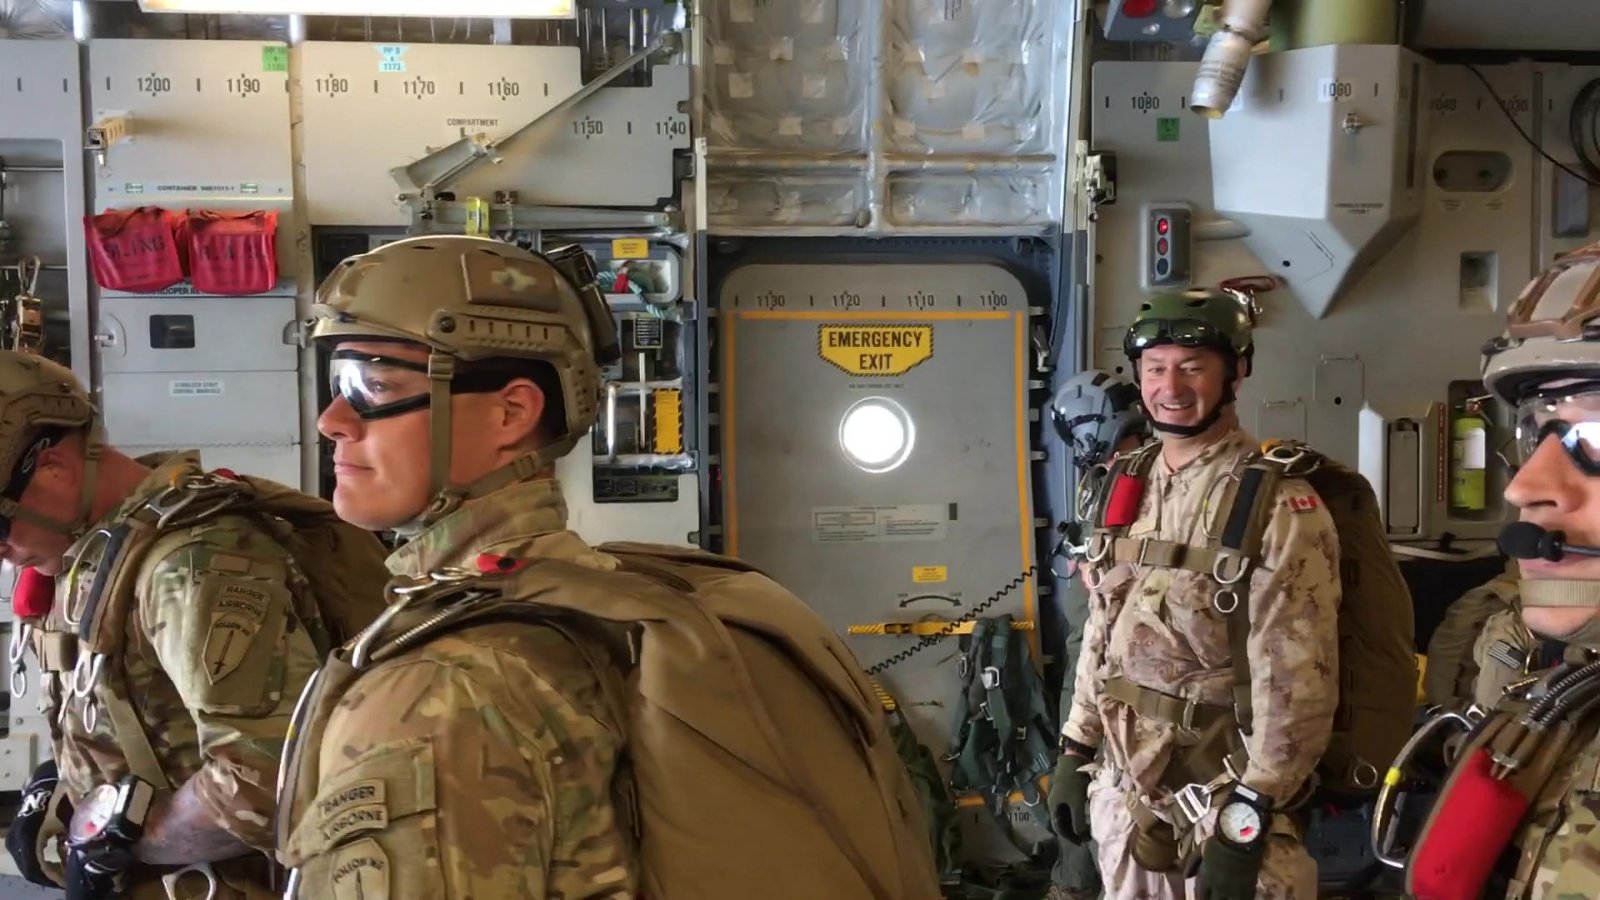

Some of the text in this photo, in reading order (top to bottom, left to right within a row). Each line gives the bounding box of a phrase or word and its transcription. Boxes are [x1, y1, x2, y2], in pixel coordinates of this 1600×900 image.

[137, 77, 520, 97] 1200 1190 1180 1170 1160
[1131, 96, 1160, 110] 1080
[447, 118, 499, 127] COMPARTMENT
[573, 120, 687, 135] 1150 1140
[757, 294, 1008, 308] 1130 1120 1110 1100
[828, 331, 923, 348] EMERGENCY
[859, 353, 893, 370] EXIT
[227, 586, 264, 600] RANGER
[323, 786, 376, 814] RANGER
[323, 809, 384, 841] AIRBORNE
